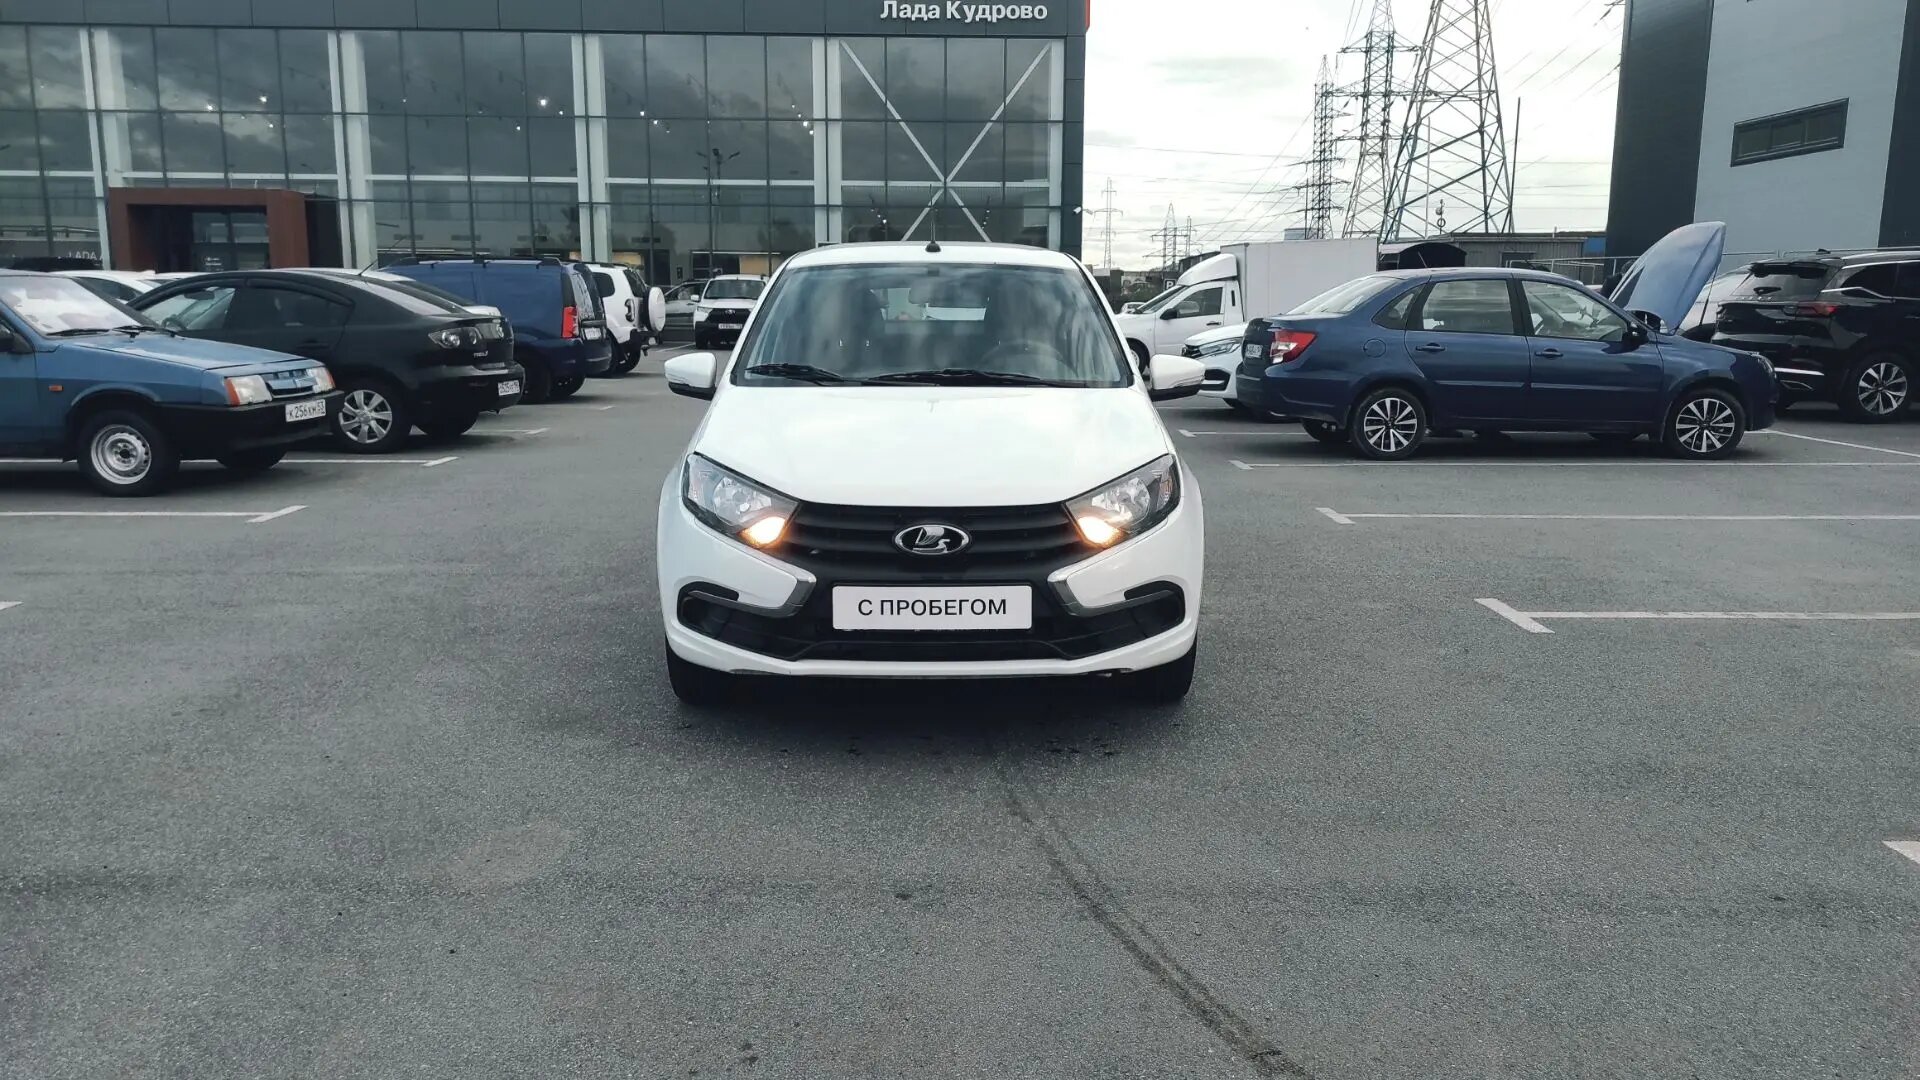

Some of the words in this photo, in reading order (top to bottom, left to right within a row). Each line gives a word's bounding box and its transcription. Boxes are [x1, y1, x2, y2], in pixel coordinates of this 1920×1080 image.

[880, 0, 940, 21] Лада
[946, 0, 1048, 23] Кудрово
[857, 598, 873, 616] С
[880, 598, 1007, 616] ПРОБЕГОМ
